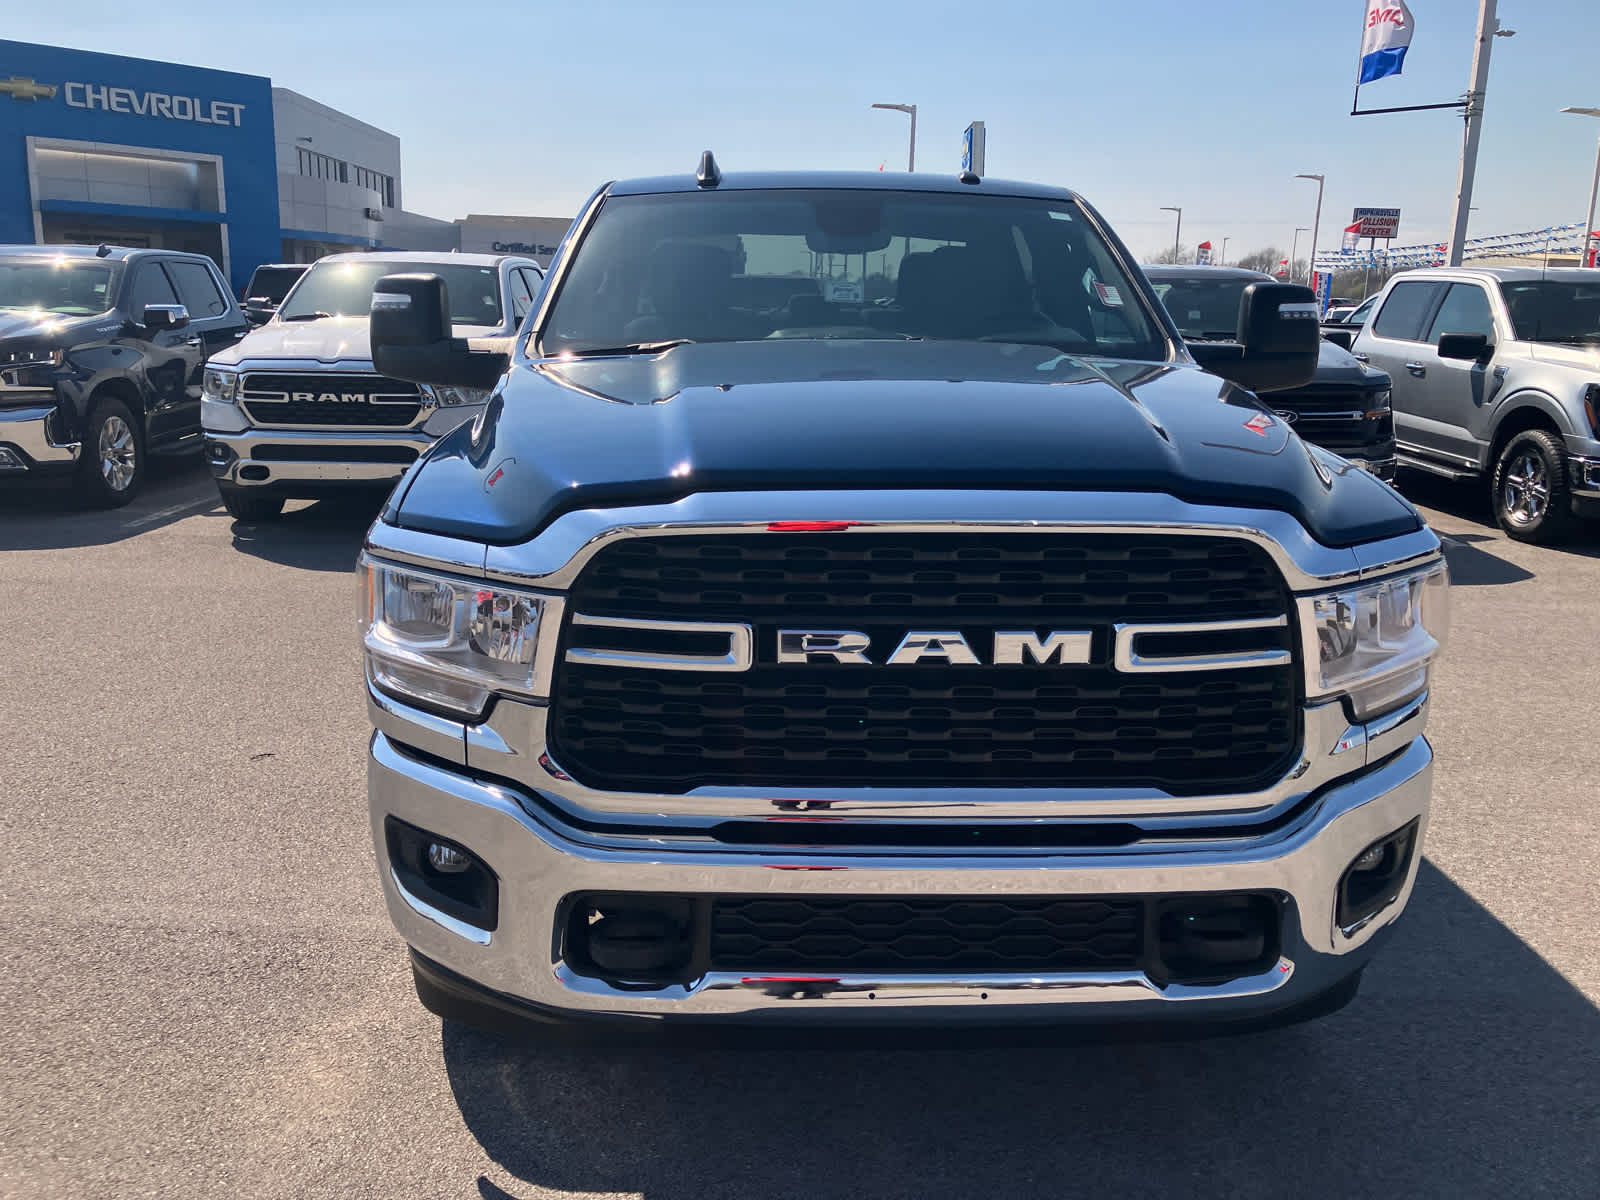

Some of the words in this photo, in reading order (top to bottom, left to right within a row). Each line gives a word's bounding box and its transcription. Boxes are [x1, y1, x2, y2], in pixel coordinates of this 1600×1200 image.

[64, 81, 246, 127] CHEVROLET
[492, 241, 536, 254] Certified
[292, 392, 365, 403] RAM
[777, 630, 1093, 665] RAM
